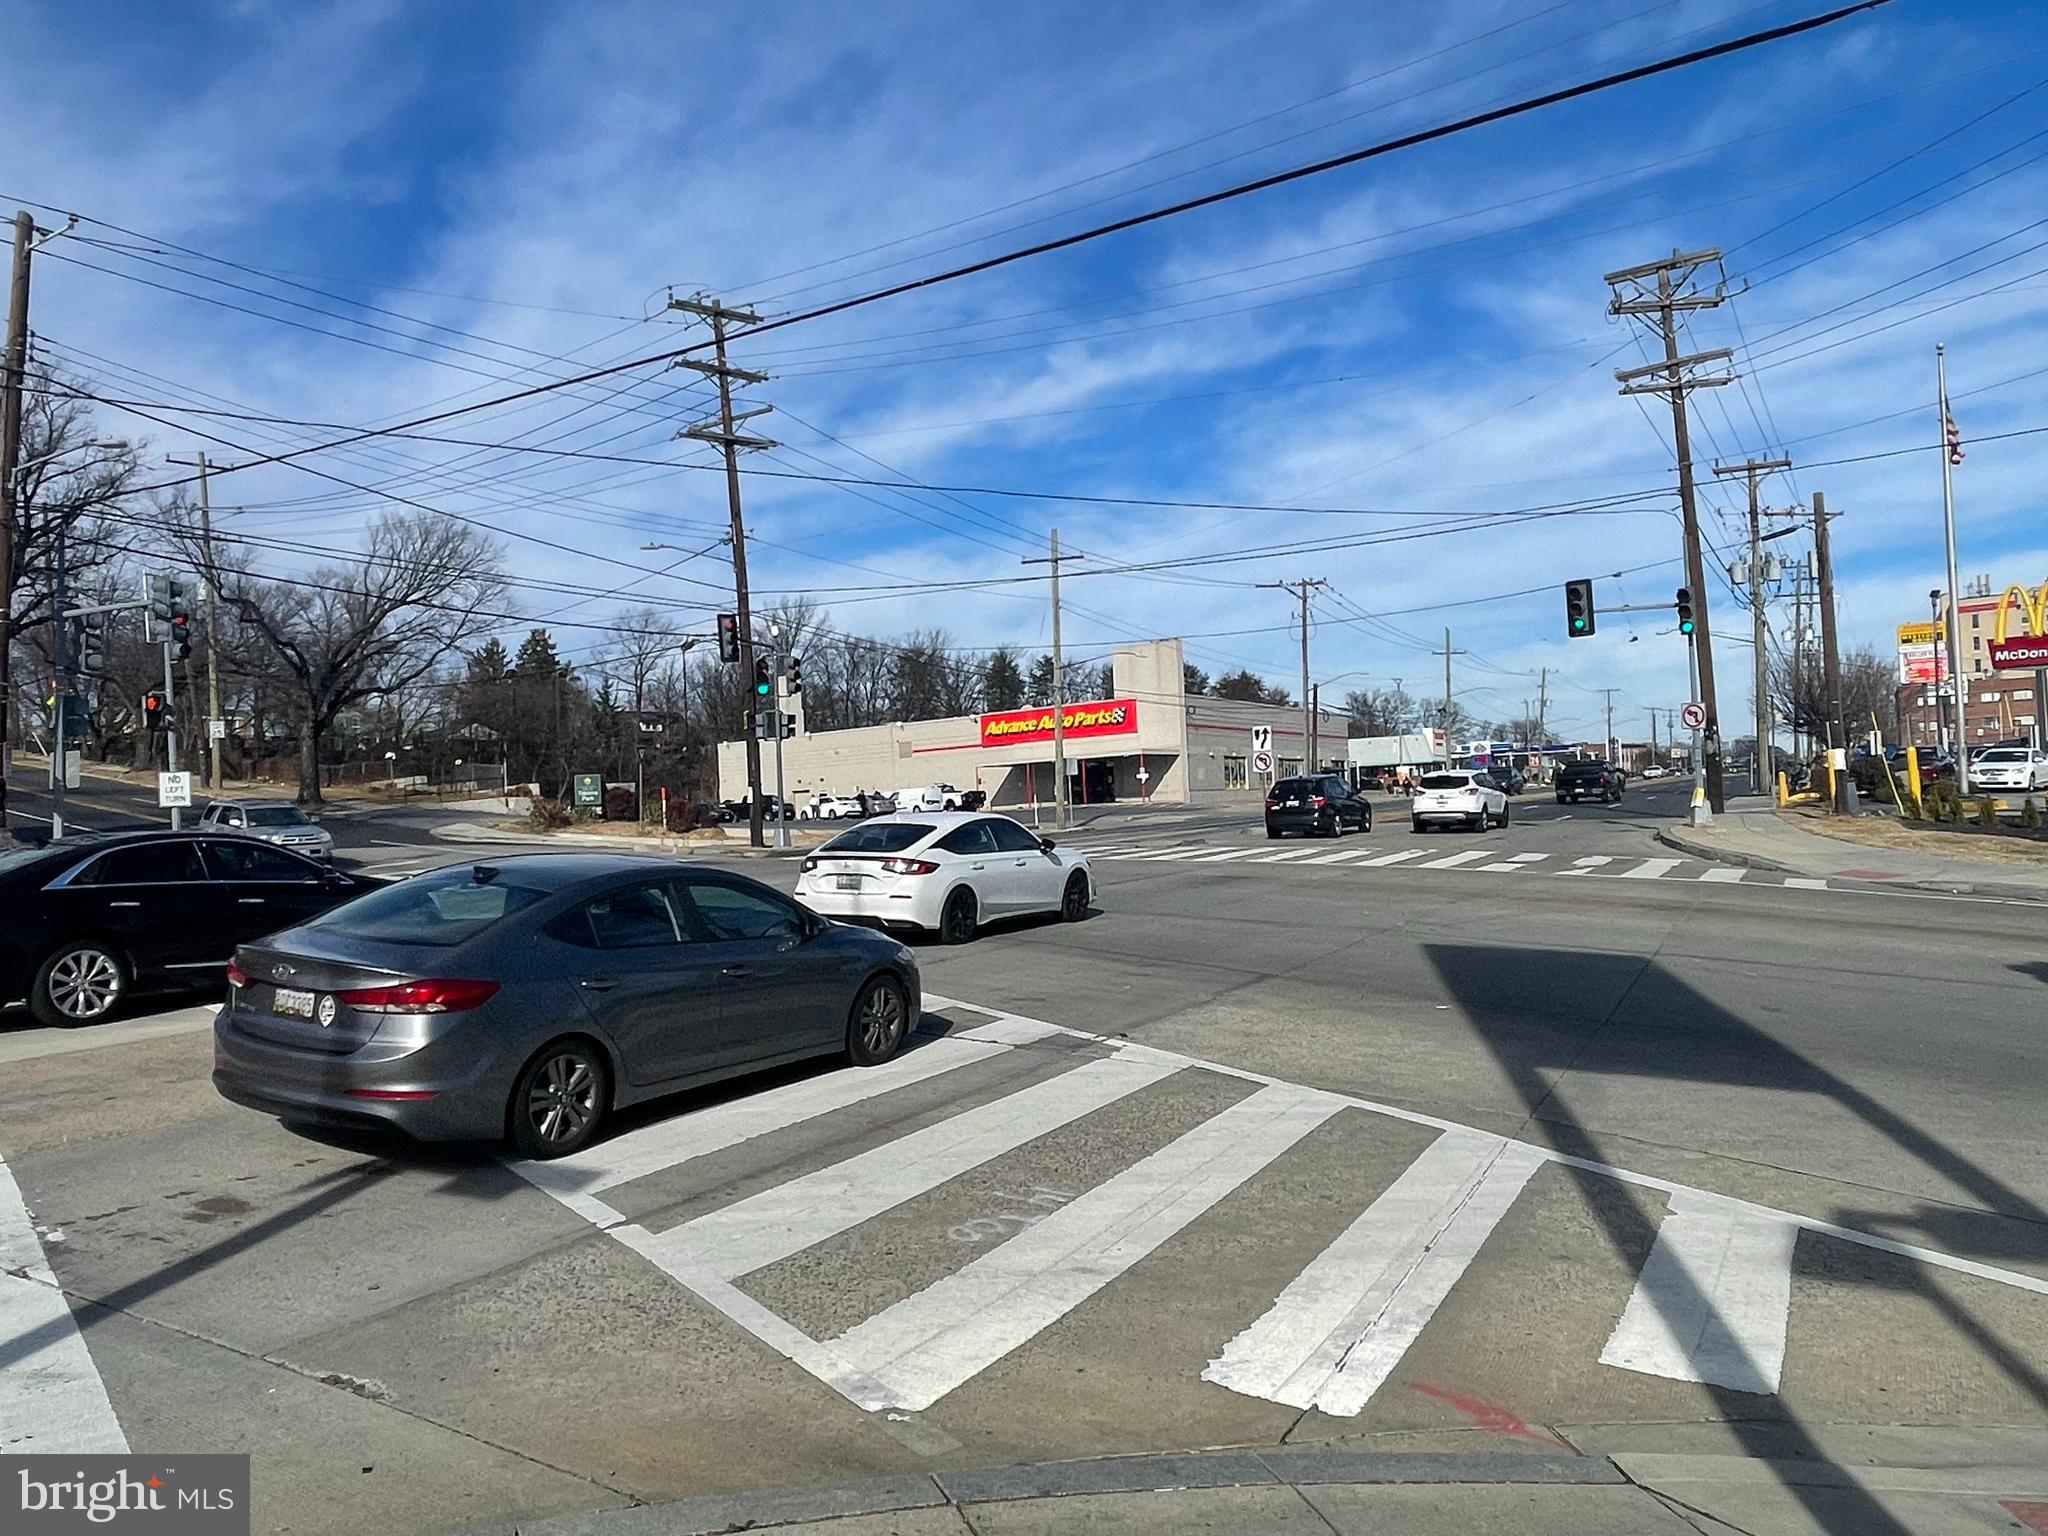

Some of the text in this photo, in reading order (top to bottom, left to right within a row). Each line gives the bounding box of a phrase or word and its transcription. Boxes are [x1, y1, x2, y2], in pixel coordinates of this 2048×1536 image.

[1995, 648, 2048, 662] McDon
[984, 709, 1113, 736] Advance Auo Parts
[167, 774, 182, 784] NO
[165, 786, 184, 794] LEFT
[165, 795, 186, 803] TURN
